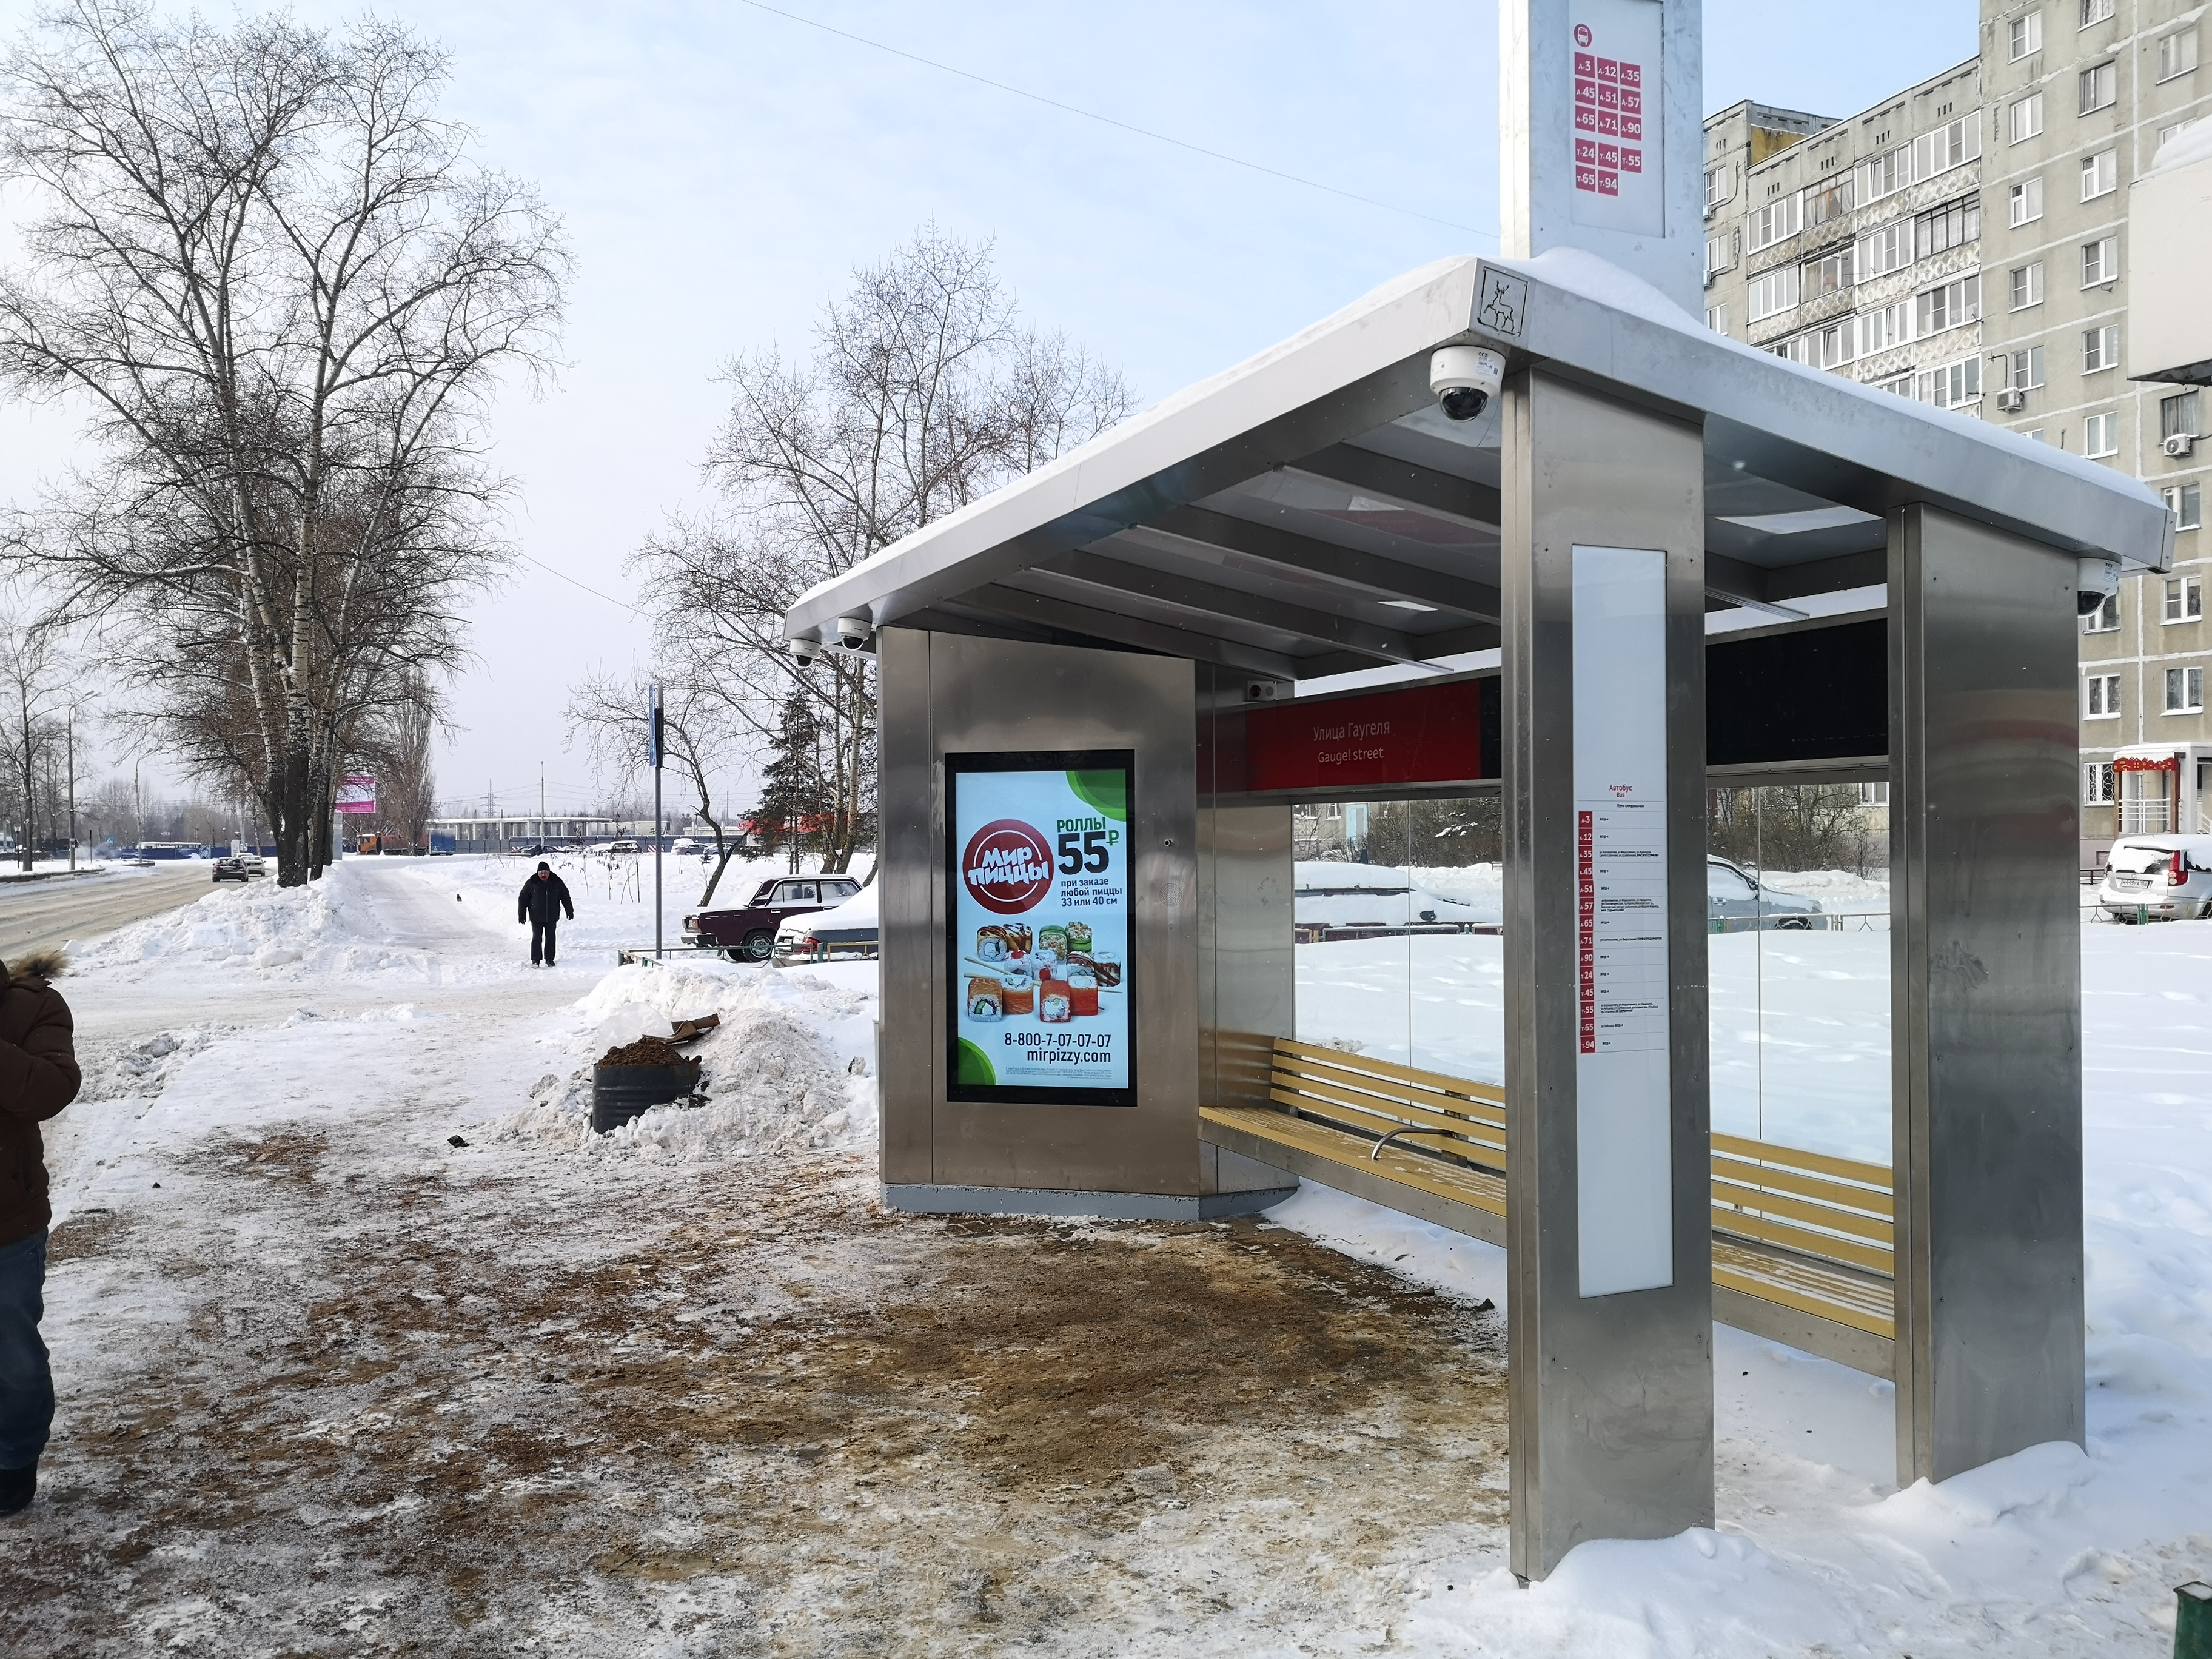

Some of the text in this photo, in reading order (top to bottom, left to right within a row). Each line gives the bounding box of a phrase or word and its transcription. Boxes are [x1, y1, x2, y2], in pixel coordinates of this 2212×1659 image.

[1313, 722, 1390, 742] Улица Гаугеля
[1318, 747, 1384, 765] Gaugel street
[1609, 784, 1632, 793] Автобус
[1057, 817, 1106, 832] РОЛЛЫ
[1061, 880, 1077, 889] при
[1061, 888, 1122, 898] любой пиццы
[1061, 898, 1072, 907] 33
[1005, 1032, 1111, 1048] 8-800-7-07-07-07
[1027, 1047, 1111, 1065] mirpizzy.com
